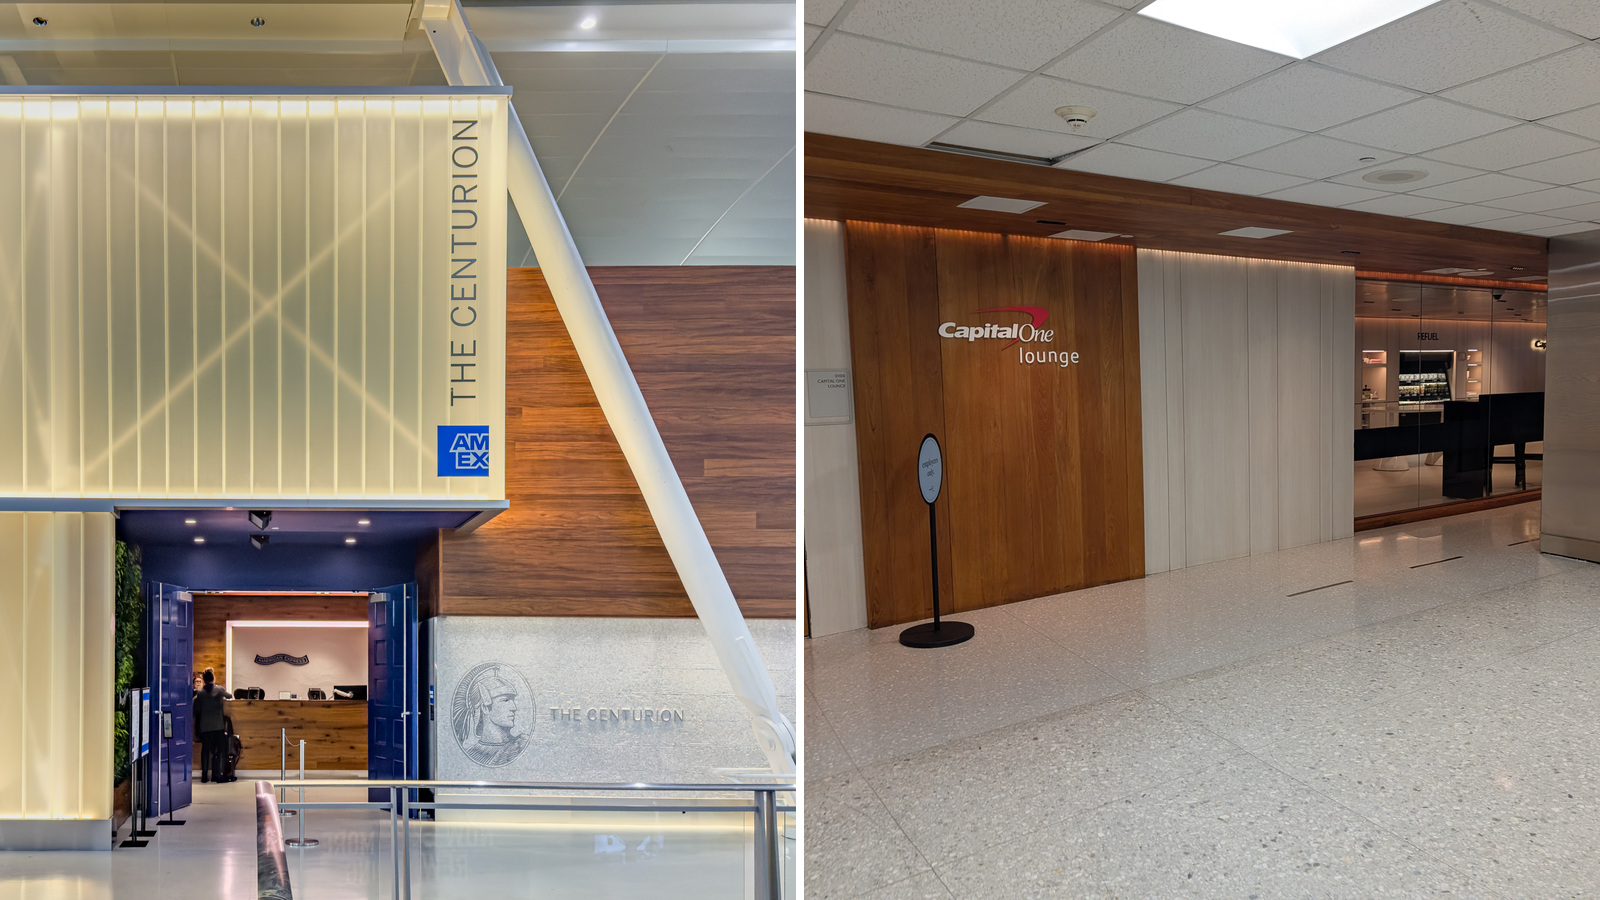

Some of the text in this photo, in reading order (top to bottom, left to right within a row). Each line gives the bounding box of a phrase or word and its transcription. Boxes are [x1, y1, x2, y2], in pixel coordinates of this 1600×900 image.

[450, 120, 479, 406] THE CENTURION
[1417, 332, 1439, 341] REFUEL
[1019, 347, 1080, 368] lounge
[550, 708, 685, 723] THE CENTURION
